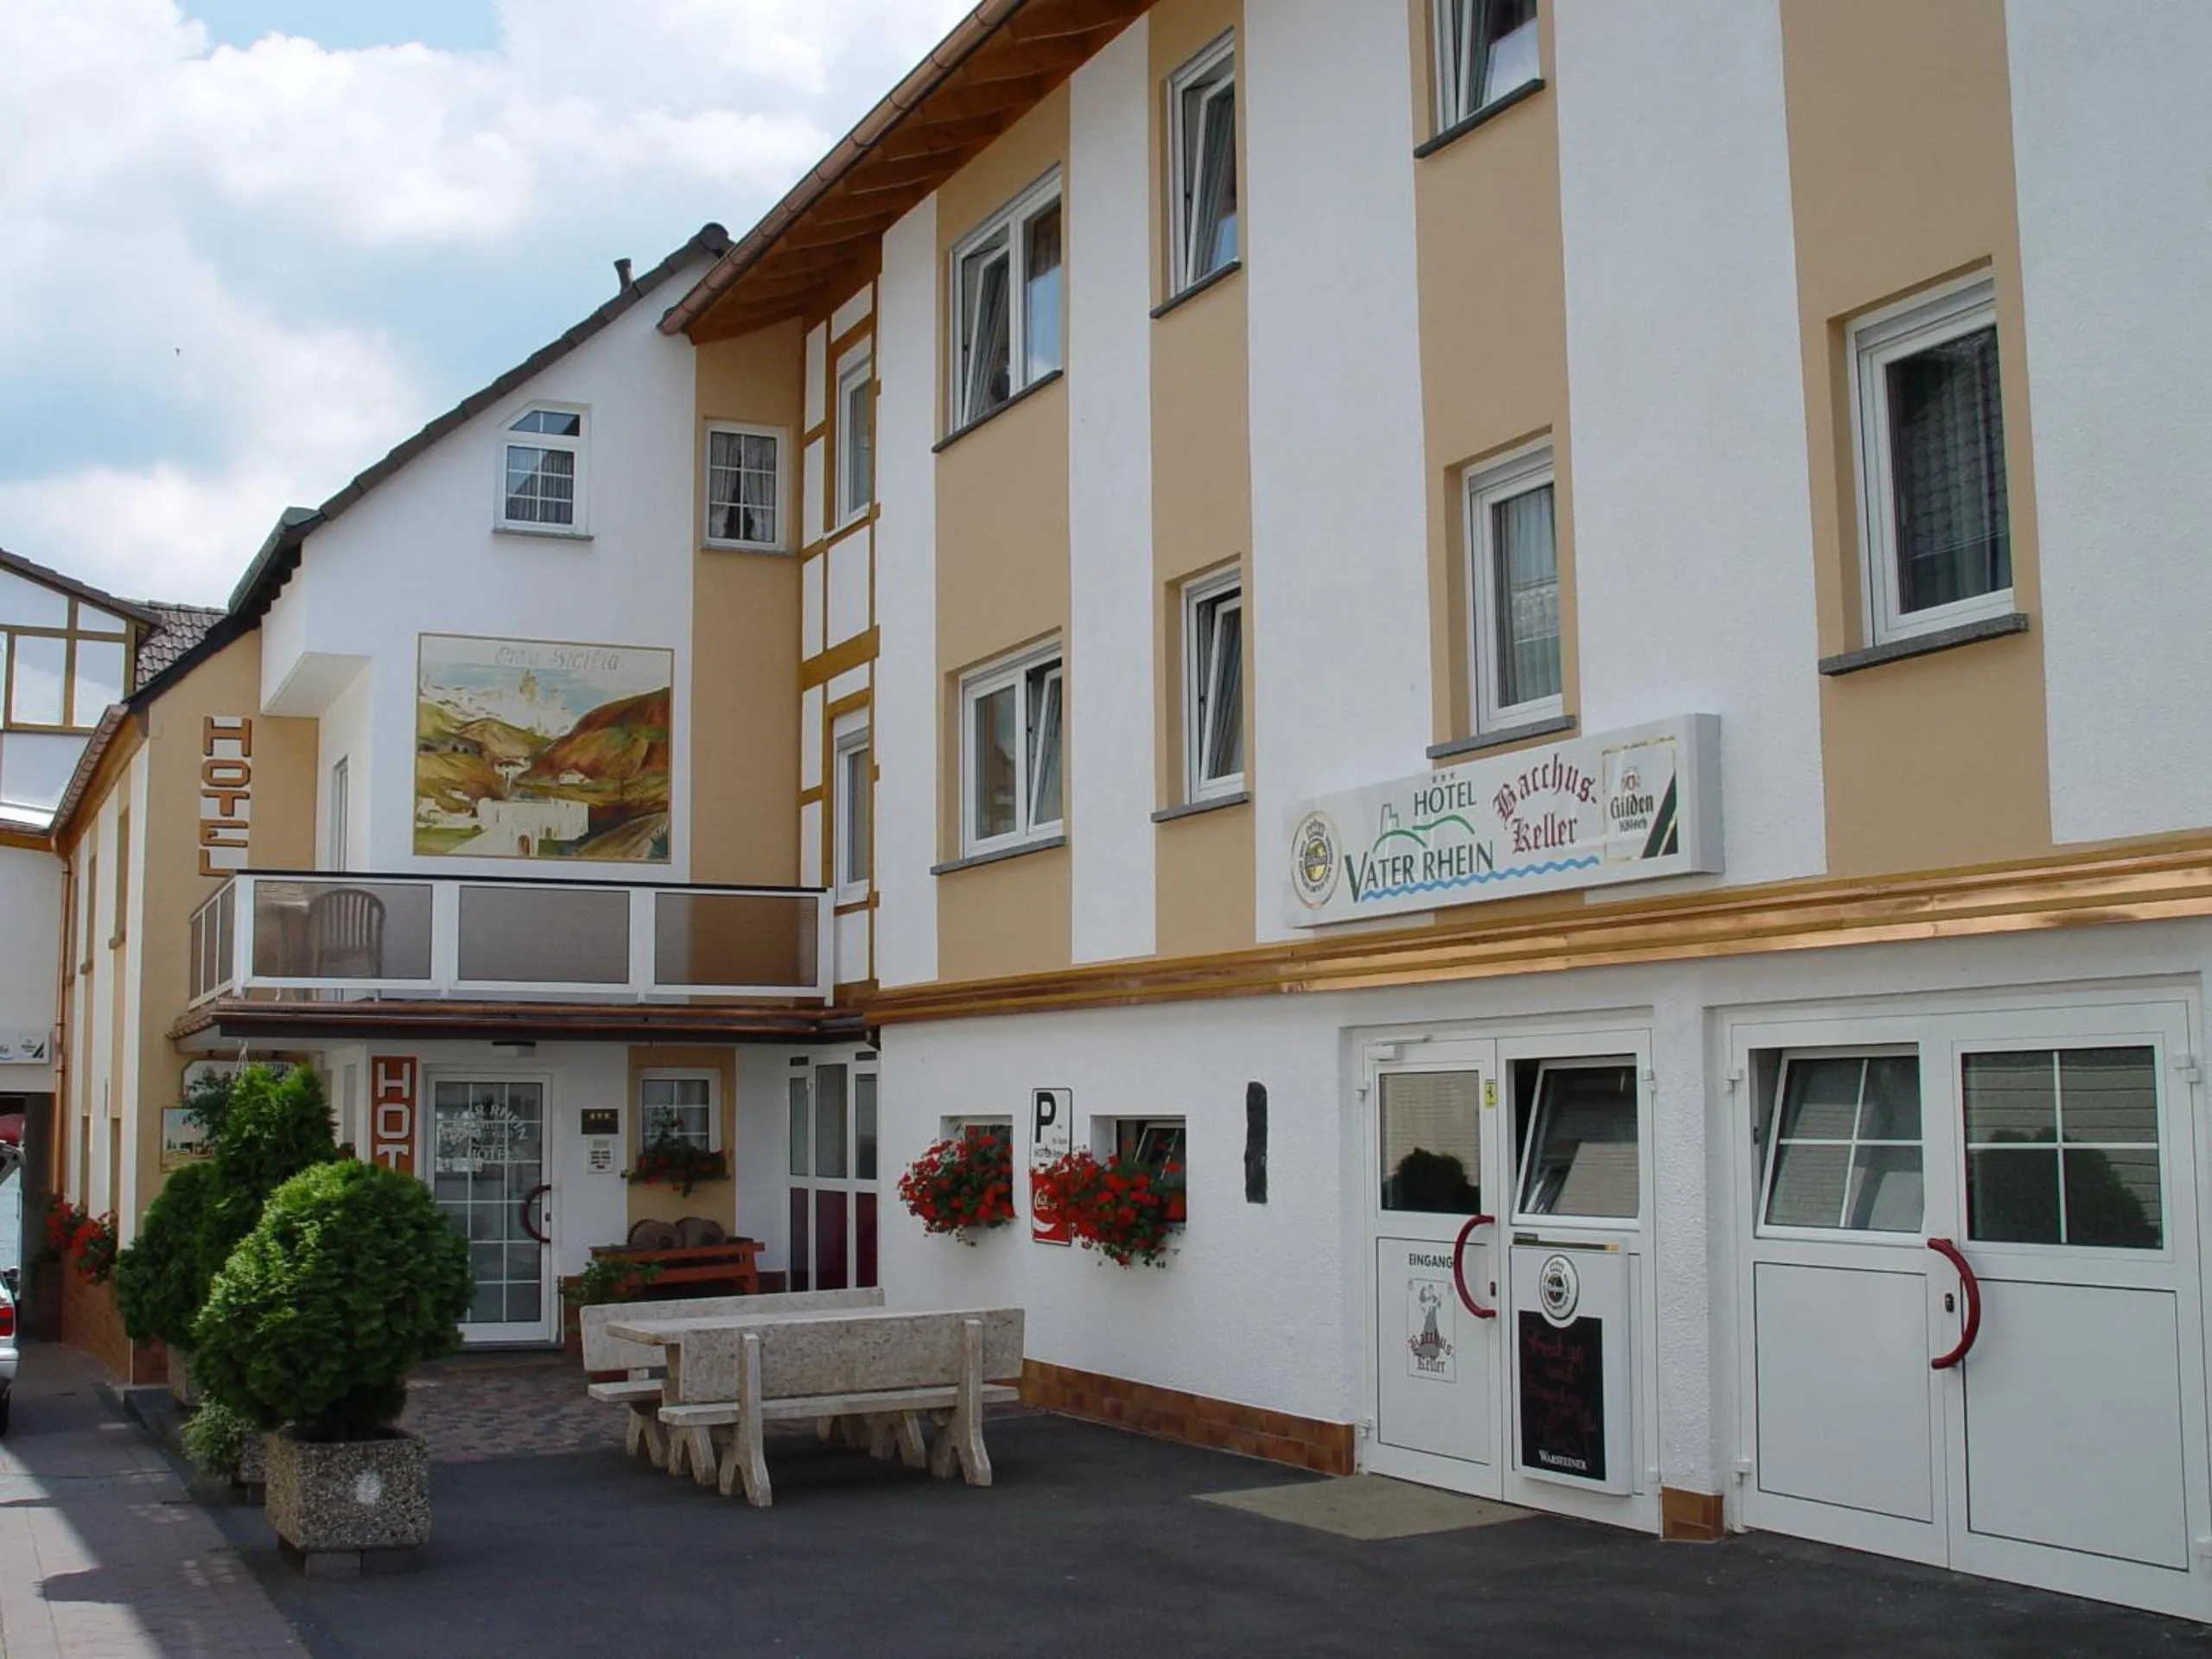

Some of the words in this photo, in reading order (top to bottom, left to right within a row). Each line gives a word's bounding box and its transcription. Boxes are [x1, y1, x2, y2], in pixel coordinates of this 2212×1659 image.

[200, 716, 252, 876] HOTEL
[1414, 780, 1477, 816] HOTEL
[1610, 793, 1654, 820] Gilden
[1512, 811, 1578, 854] Keller
[1344, 851, 1414, 903] VATER
[1423, 840, 1493, 881] RHEIN
[1035, 1092, 1056, 1143] P
[1408, 1253, 1453, 1268] EINGANG
